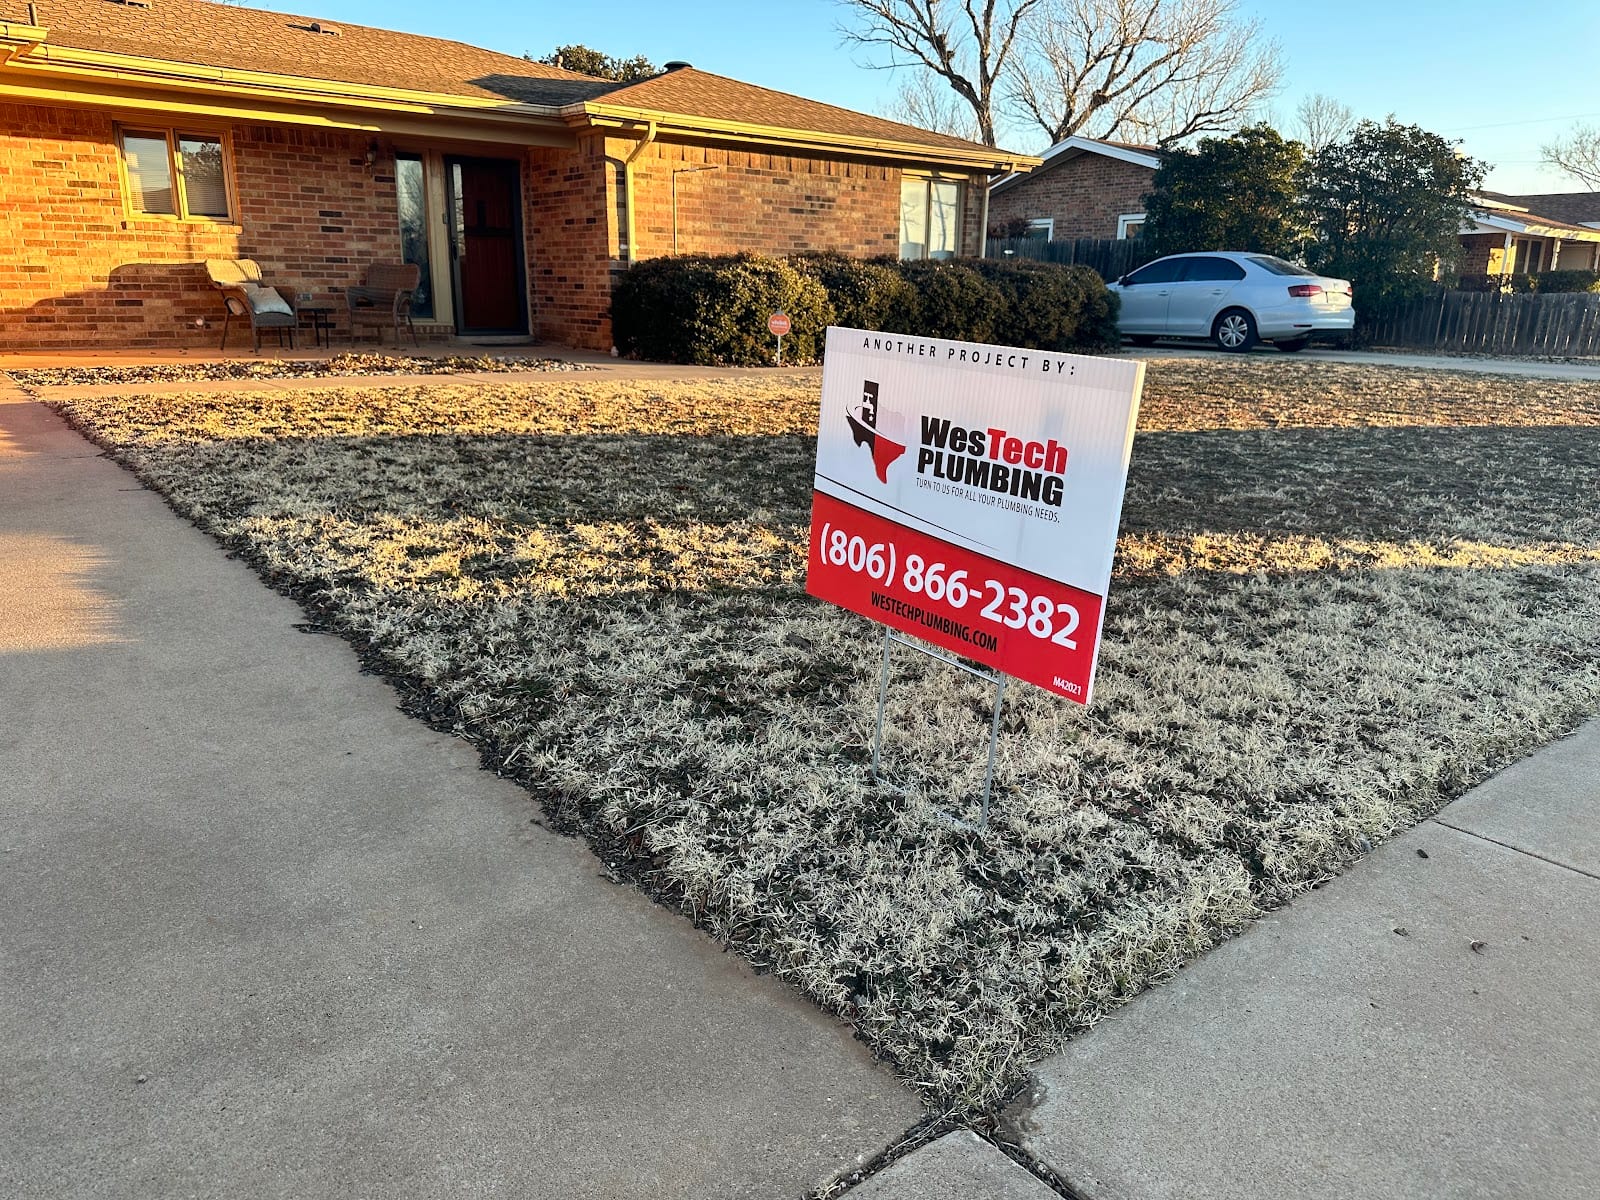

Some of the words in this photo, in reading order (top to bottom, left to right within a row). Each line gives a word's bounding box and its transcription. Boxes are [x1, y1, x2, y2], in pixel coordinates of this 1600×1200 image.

[863, 337, 936, 357] ANOTHER
[948, 348, 1028, 369] PROJECT
[1042, 359, 1075, 376] BY:
[921, 415, 1068, 475] WesTech
[916, 477, 932, 490] TURN
[932, 481, 941, 492] TO
[941, 483, 950, 495] US
[951, 486, 964, 498] FOR
[964, 490, 976, 502] ALL
[978, 492, 996, 507] YOUR
[997, 498, 1033, 516] PLUMBING
[1034, 507, 1060, 523] NEEDS.
[917, 447, 1064, 507] PLUMBING
[820, 522, 896, 587] (806)
[903, 554, 1081, 650] 866-2382
[871, 590, 998, 653] WESTECHPLUMBING.COM
[1052, 675, 1082, 696] M42021
